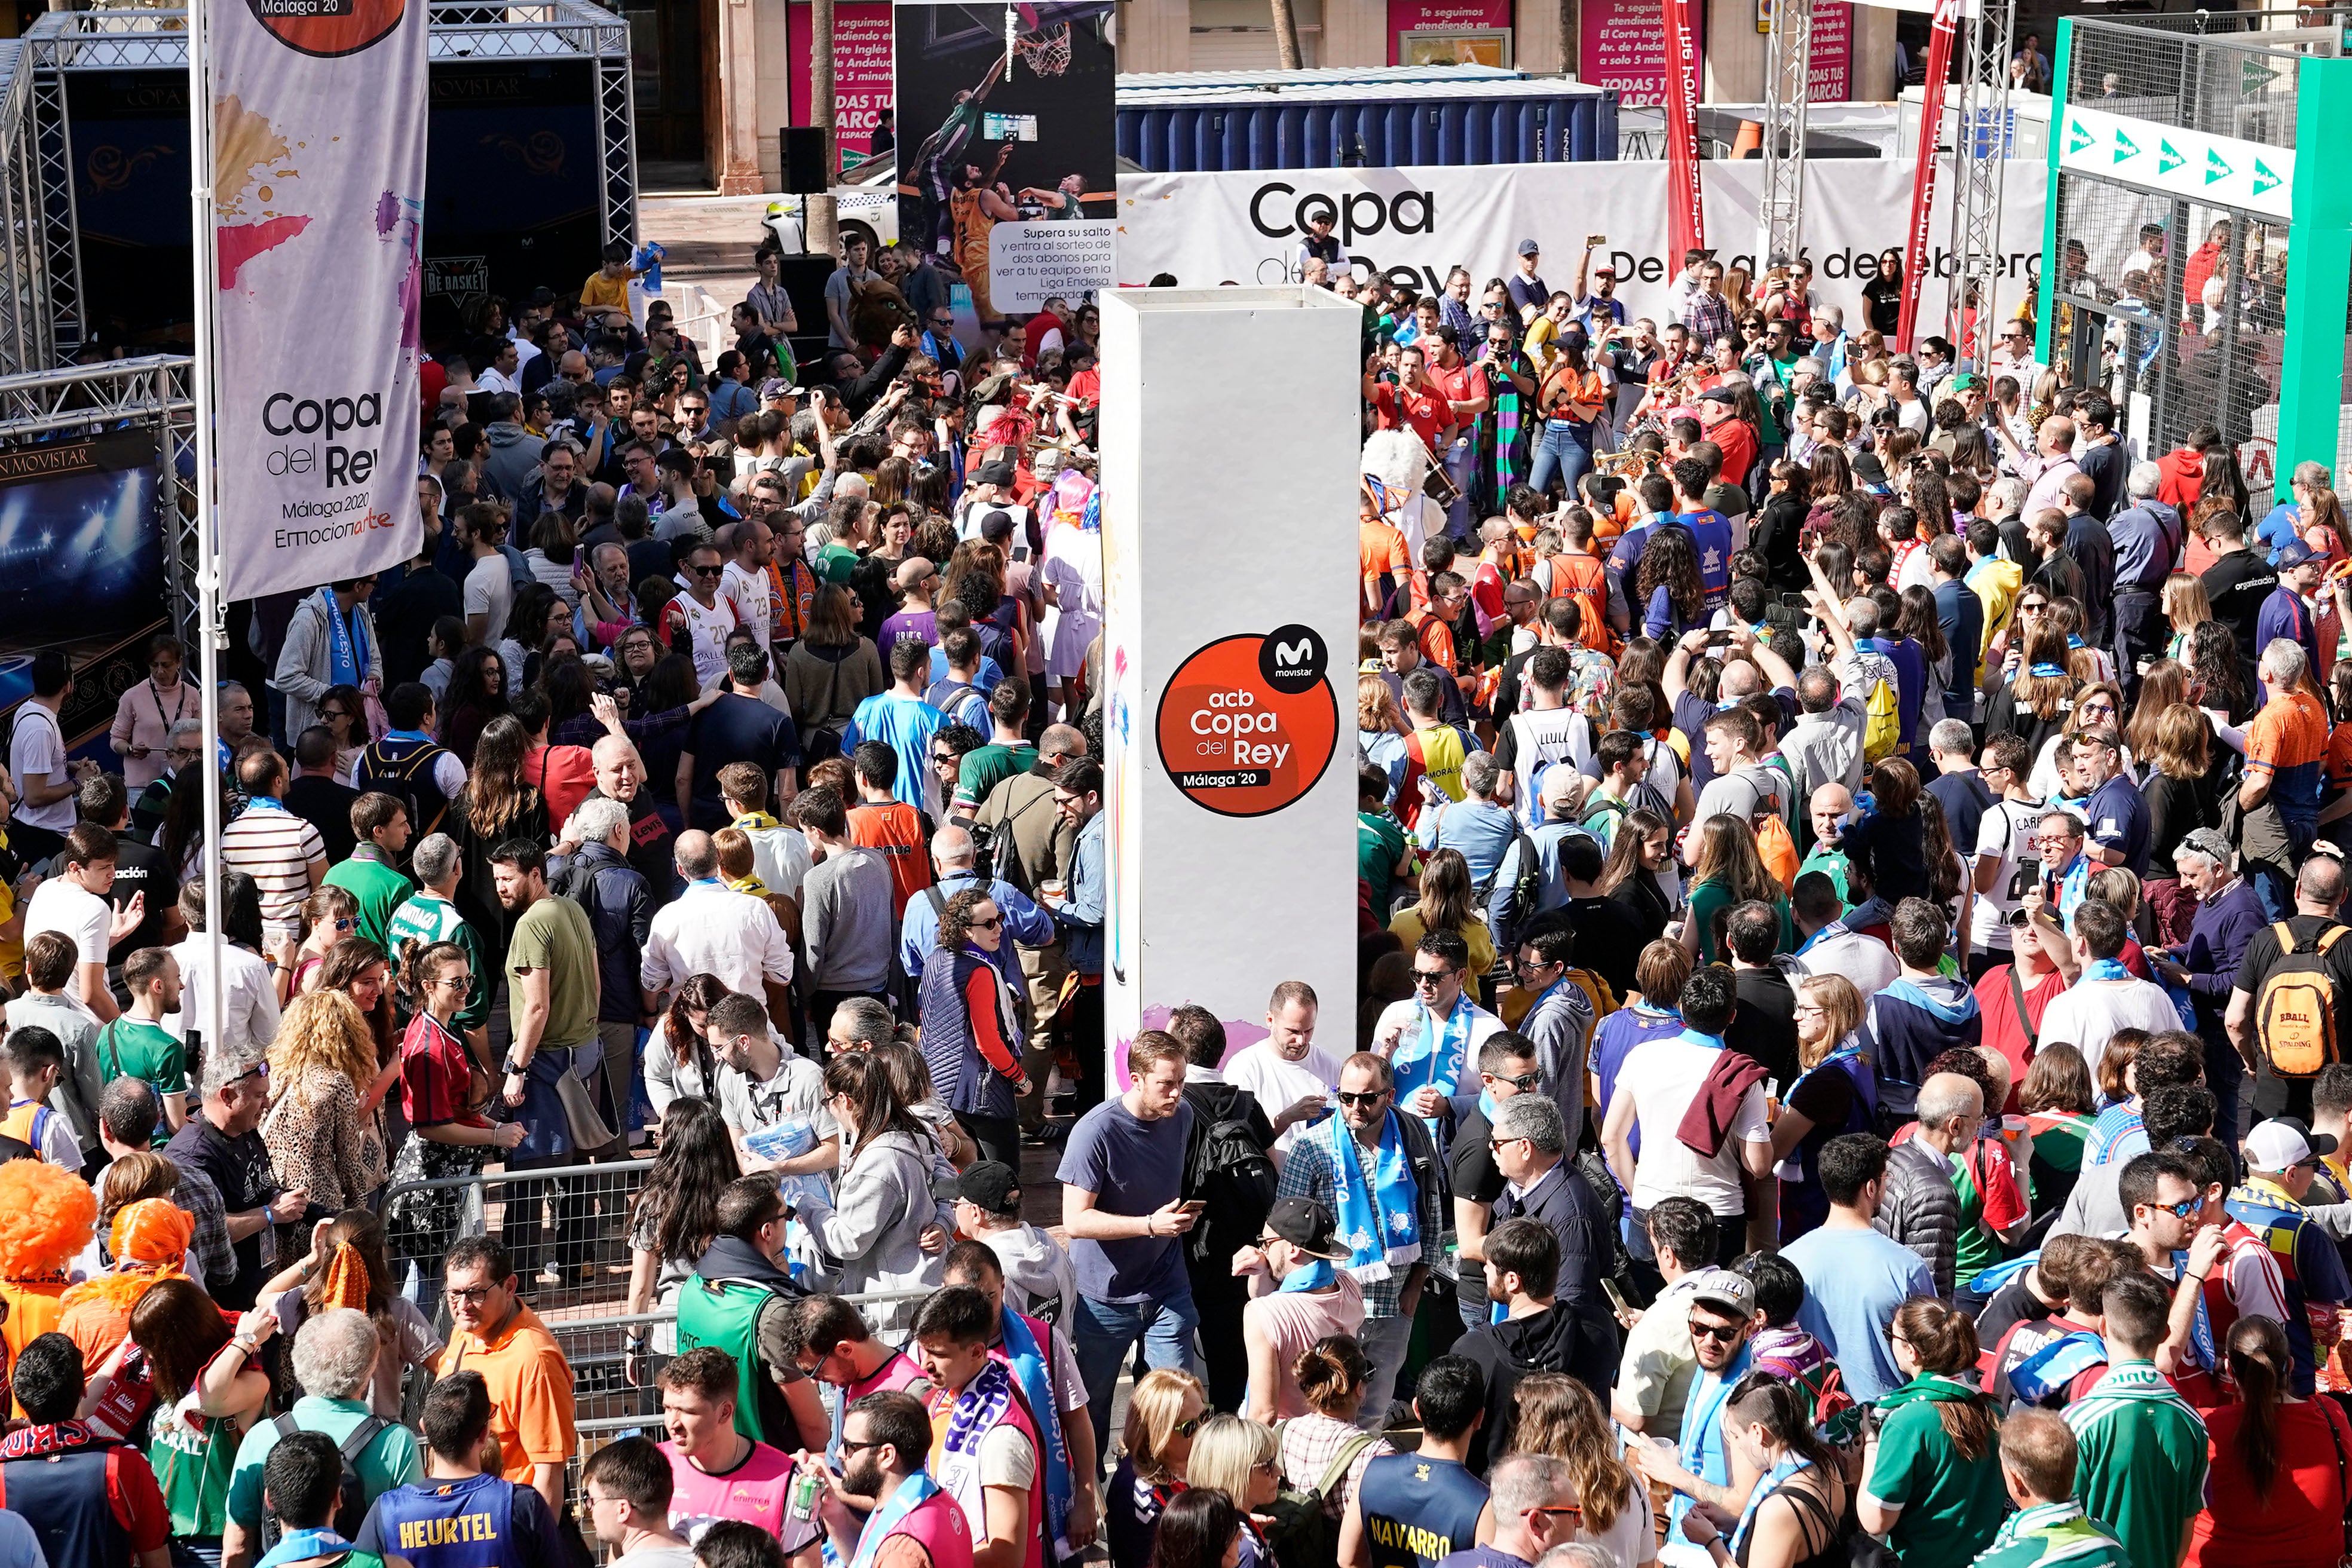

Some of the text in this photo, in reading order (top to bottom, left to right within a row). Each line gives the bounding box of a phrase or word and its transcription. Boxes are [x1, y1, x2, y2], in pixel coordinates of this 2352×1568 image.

[1421, 8, 1484, 19] Te seguimos
[1614, 4, 1662, 14] Te seguim
[837, 18, 890, 30] seguimos
[834, 29, 881, 41] ndiendo
[1600, 28, 1665, 40] El Corte Ingl
[834, 44, 887, 57] orte Inglés
[1598, 41, 1665, 52] Av. de Andal
[846, 58, 892, 68] Andaluc
[1610, 56, 1631, 65] solo
[1634, 56, 1641, 65] 5
[846, 72, 853, 81] 5
[855, 72, 892, 81] minut
[1830, 66, 1844, 79] TUS
[835, 94, 869, 109] DAS
[1250, 182, 1434, 247] Copa
[1023, 227, 1110, 239] Supera su salto
[1009, 242, 1040, 252] entra
[1043, 241, 1054, 251] al
[1056, 240, 1092, 250] sorteo
[1095, 239, 1111, 249] de
[1012, 253, 1111, 264] dos abonos para
[1611, 250, 1664, 283] De
[1823, 246, 1877, 279] de
[996, 265, 1111, 278] ver a tu equipo en la
[427, 270, 485, 292] BE BASKET
[1040, 277, 1111, 290] Liga Endesa,
[262, 392, 382, 441] Copa
[12, 448, 88, 474] MOVISTAR
[267, 442, 317, 476] del
[283, 491, 370, 519] Málaga 2020
[275, 507, 396, 549] Emocionarte
[2235, 575, 2276, 591] organización
[1275, 668, 1313, 677] movistar
[1208, 689, 1254, 708] acb
[1190, 709, 1277, 739] Copa
[1540, 733, 1569, 745] LLULL
[1196, 739, 1291, 769] del Rey
[1183, 771, 1236, 788] Málaga
[2280, 1013, 2310, 1023] BBALL
[2279, 1040, 2311, 1049] SPALDING
[1708, 1280, 1744, 1296] IBIZA
[399, 1512, 498, 1550] HEURTEL
[1371, 1516, 1450, 1561] NAVARRO
